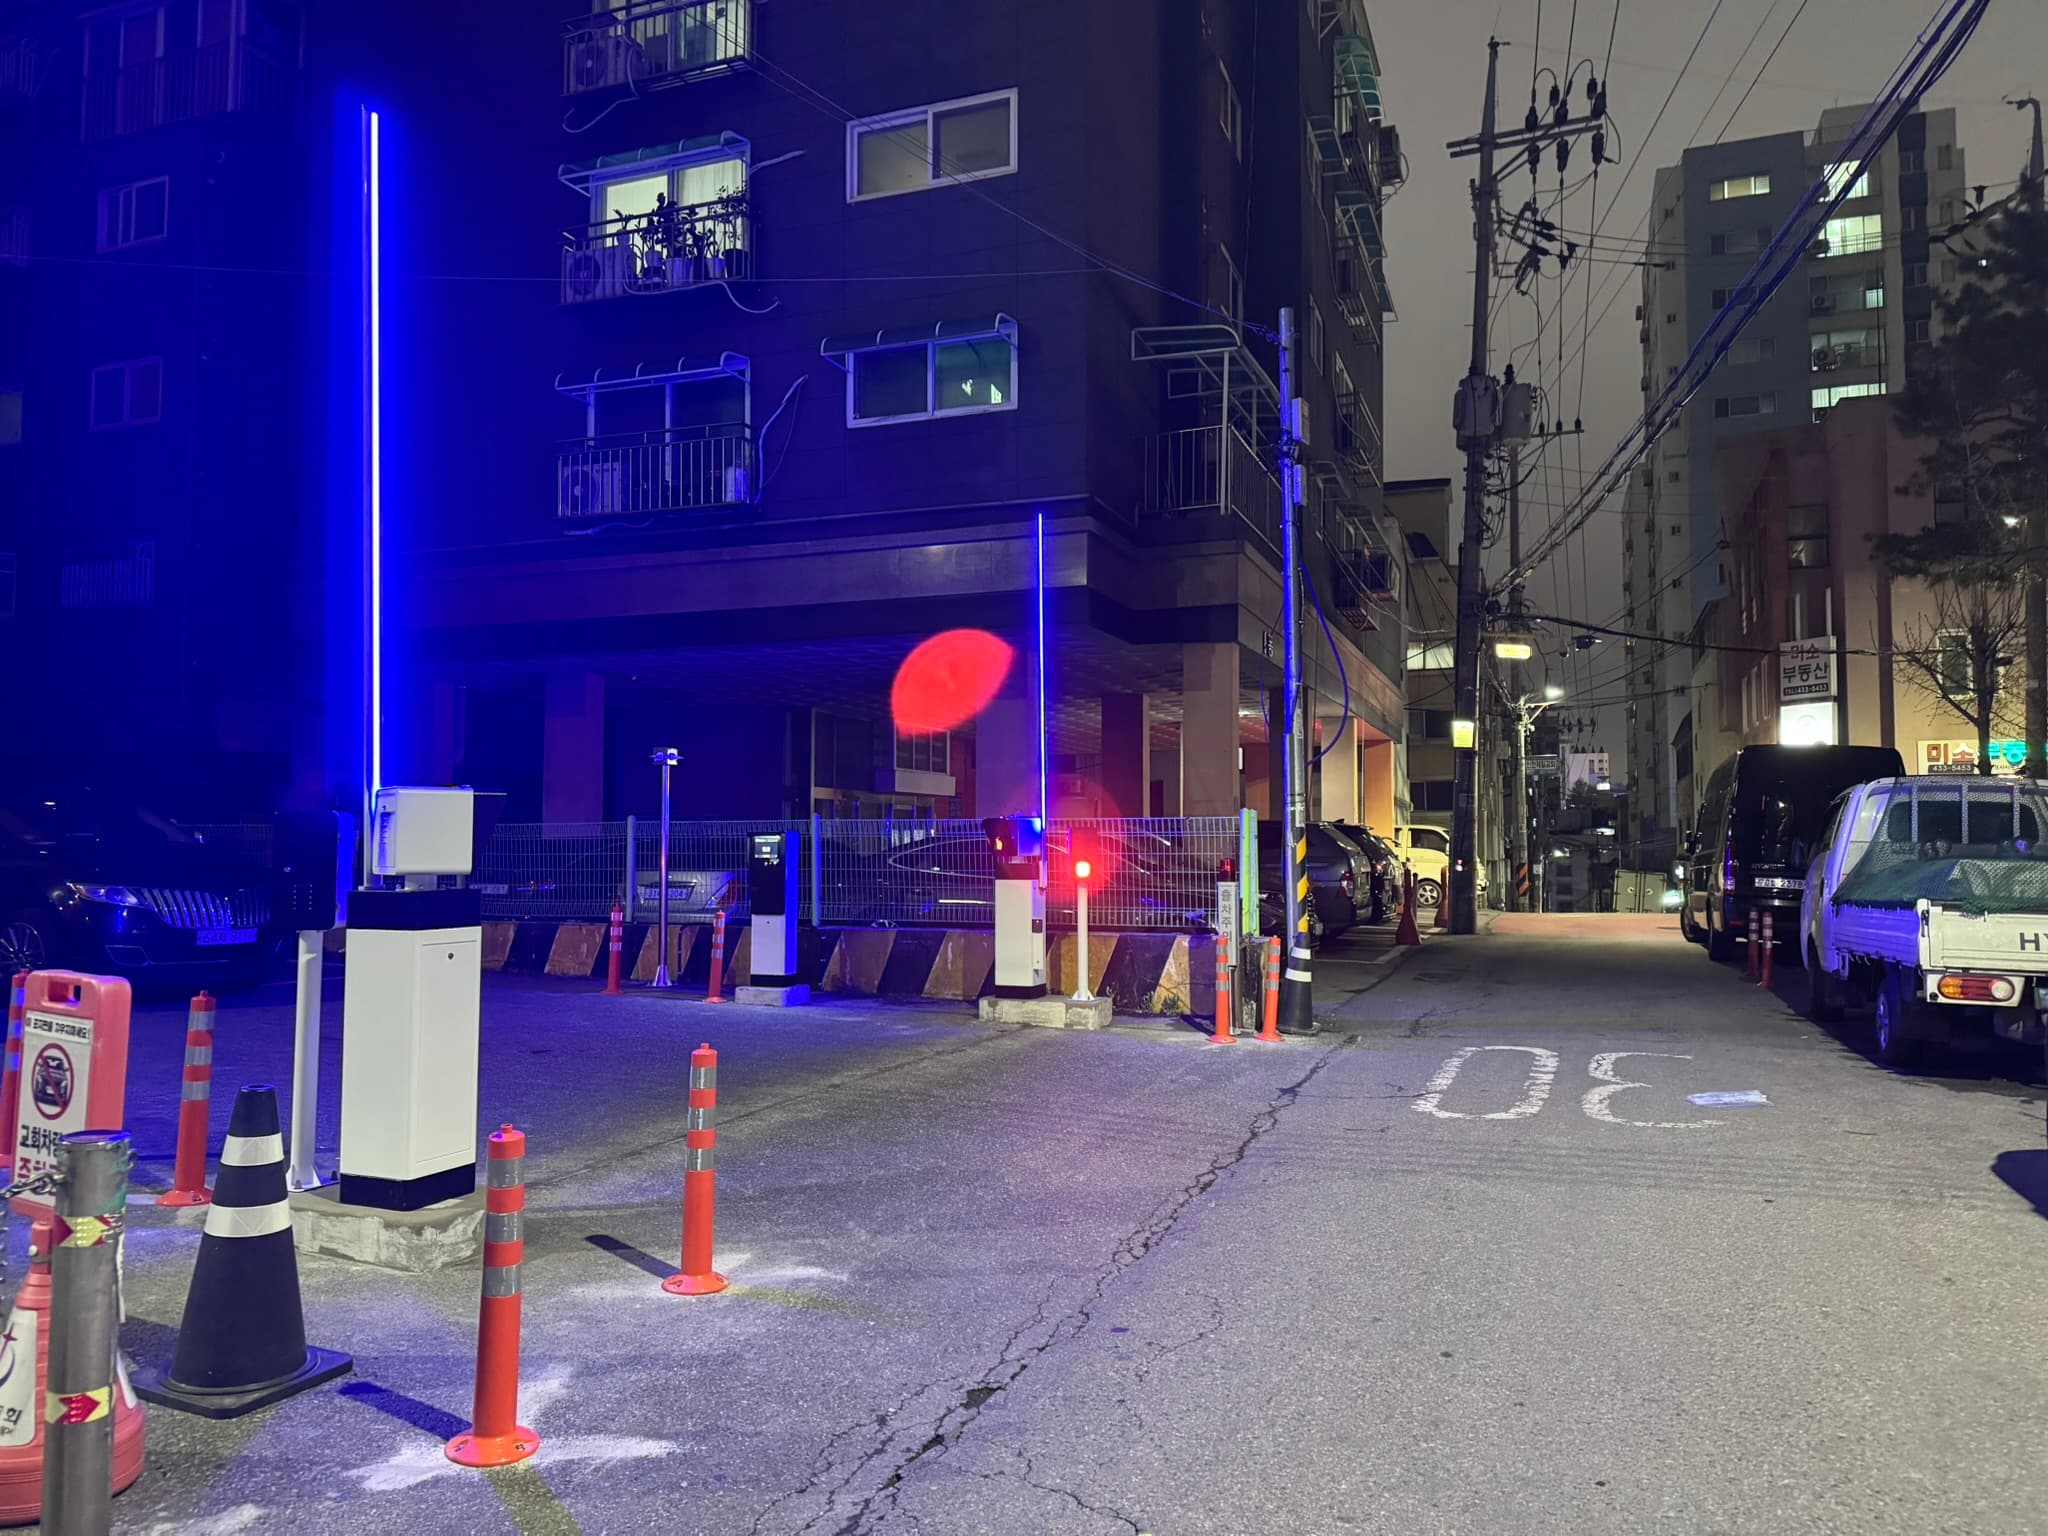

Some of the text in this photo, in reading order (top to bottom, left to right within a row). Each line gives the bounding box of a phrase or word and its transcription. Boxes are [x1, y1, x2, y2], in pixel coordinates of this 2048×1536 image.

[1791, 642, 1820, 662] 미소
[1783, 662, 1828, 684] 부동산
[1926, 742, 1975, 764] 미소
[1932, 764, 1972, 772] 433-5453
